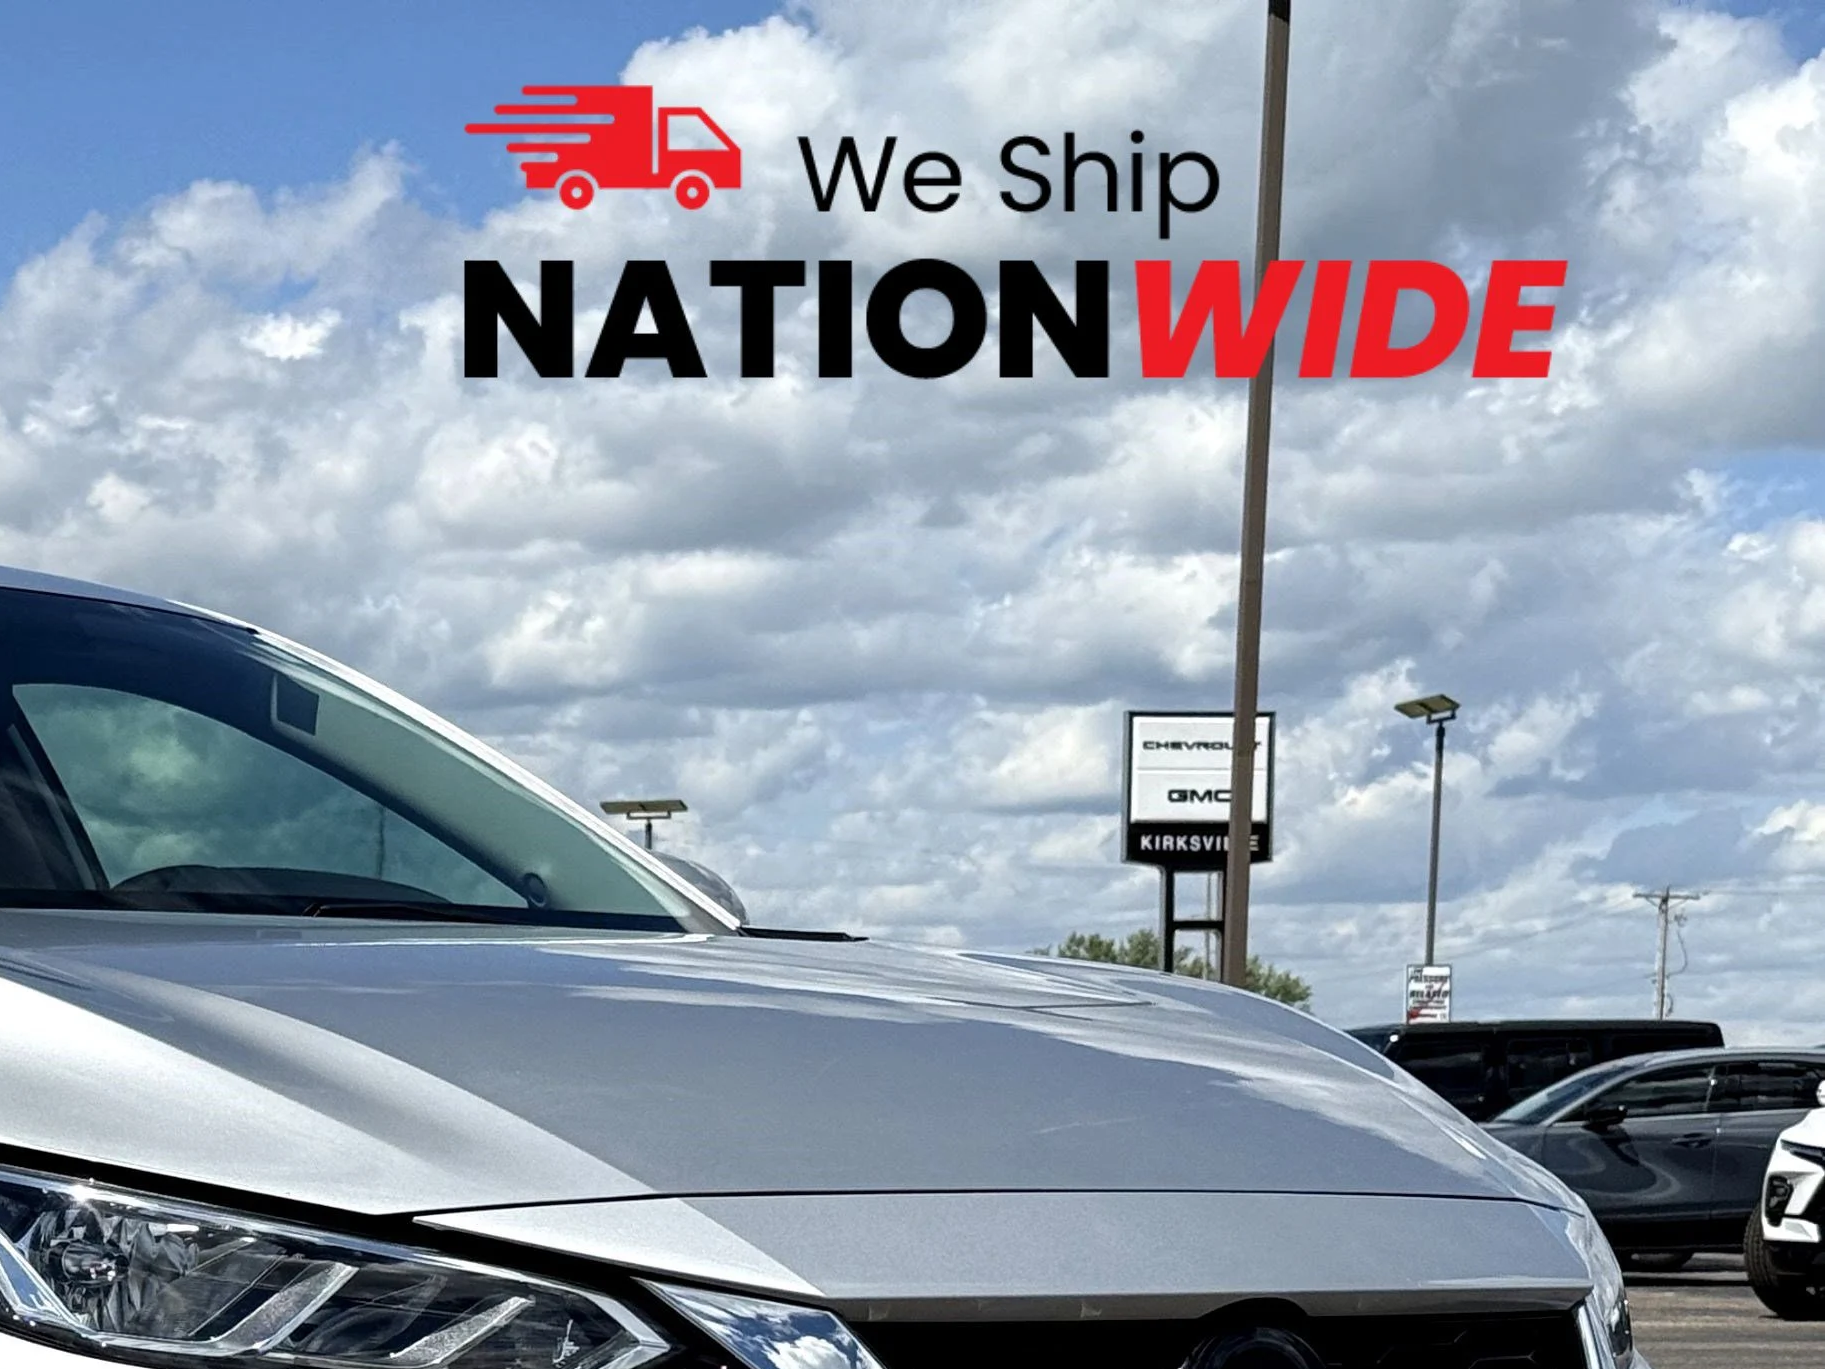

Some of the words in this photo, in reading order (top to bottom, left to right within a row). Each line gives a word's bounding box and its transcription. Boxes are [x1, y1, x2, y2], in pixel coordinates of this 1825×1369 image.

[1142, 740, 1262, 751] CHEVROLT
[1167, 788, 1232, 804] GMC
[1140, 834, 1260, 851] KIRKSVILE
